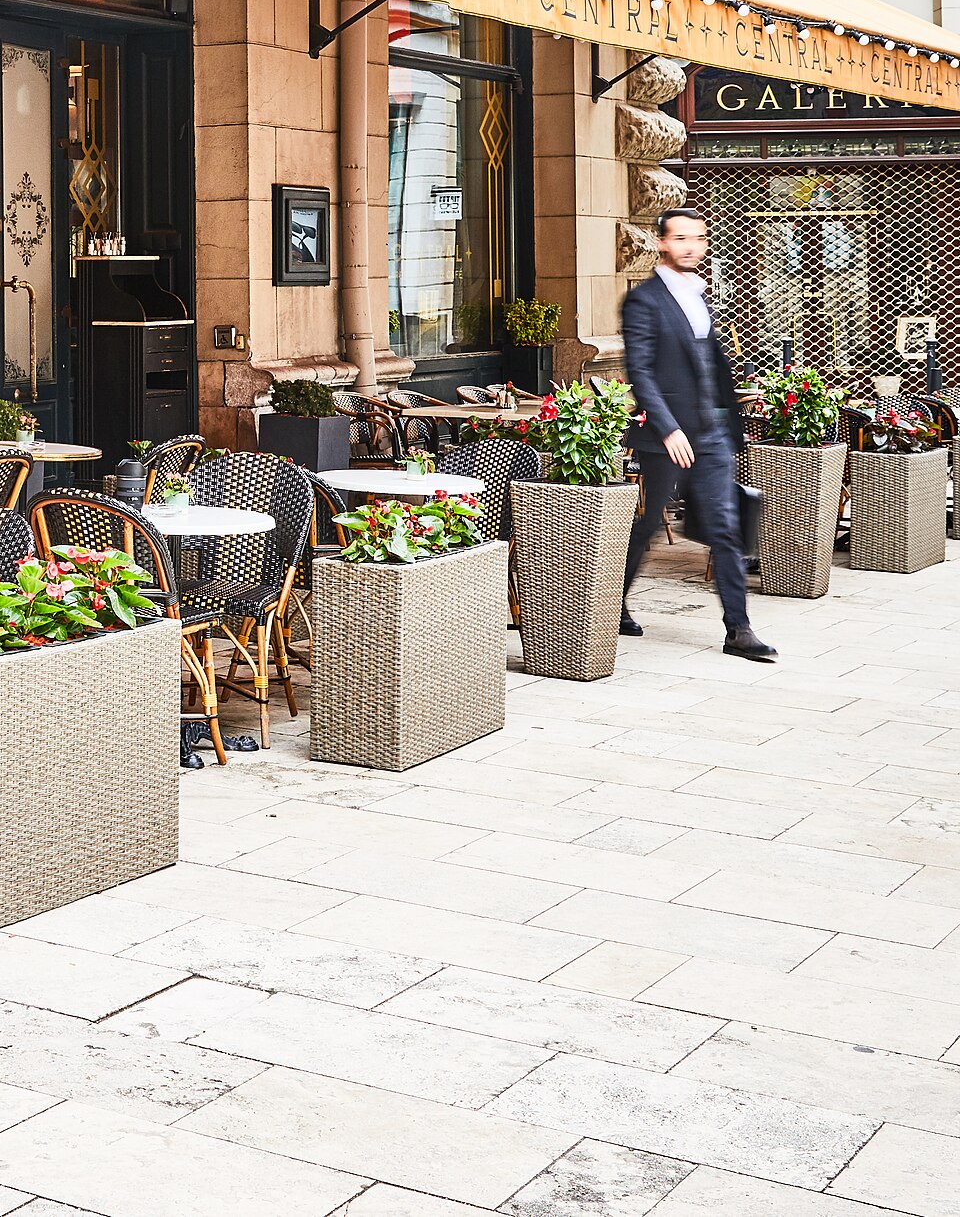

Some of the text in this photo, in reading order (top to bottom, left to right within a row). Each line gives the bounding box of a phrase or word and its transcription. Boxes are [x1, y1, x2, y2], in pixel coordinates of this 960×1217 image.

[735, 19, 833, 75] CENTRAL
[870, 51, 943, 97] CENTRAL
[716, 83, 938, 111] GALER
